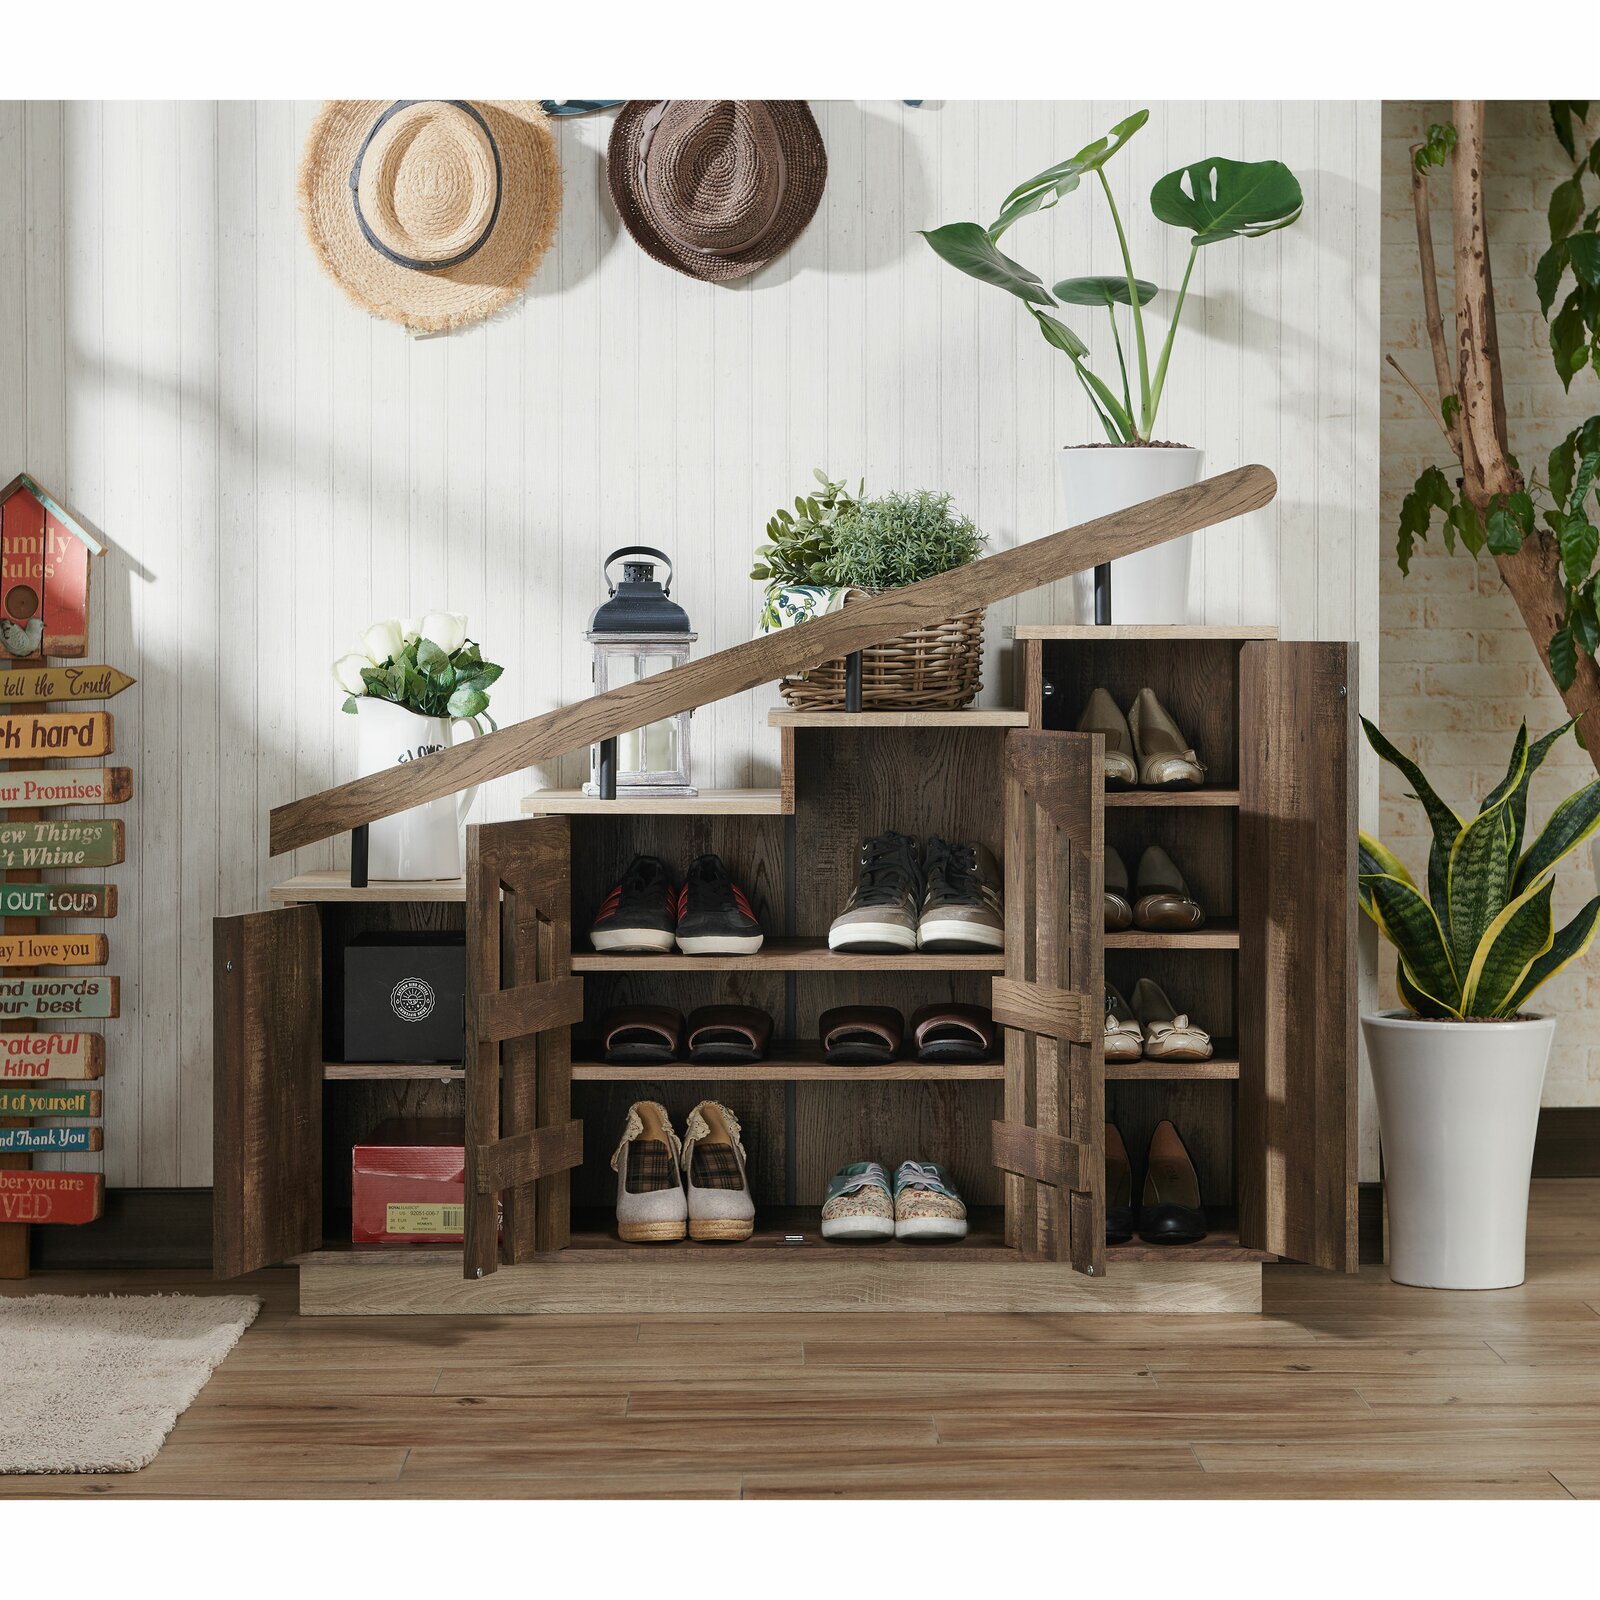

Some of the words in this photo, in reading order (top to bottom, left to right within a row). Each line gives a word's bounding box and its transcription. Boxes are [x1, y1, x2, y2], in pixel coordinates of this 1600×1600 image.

[4, 676, 24, 696] tell
[34, 673, 54, 696] the
[65, 668, 112, 696] Truth
[31, 718, 95, 748] hard
[24, 779, 102, 801] Promises
[0, 827, 26, 845] ew
[34, 824, 103, 844] Things
[22, 847, 85, 866] Whine
[7, 892, 45, 911] OUT
[49, 892, 98, 912] LOUD
[18, 940, 24, 957] I
[28, 940, 58, 957] love
[63, 942, 90, 961] you
[31, 979, 100, 996] words
[36, 997, 83, 1014] best
[4, 1058, 50, 1077] kind
[12, 1094, 27, 1111] of
[29, 1094, 86, 1112] yourself
[16, 1129, 56, 1146] Thank
[58, 1128, 85, 1146] You
[27, 1177, 56, 1194] you
[59, 1178, 84, 1191] are
